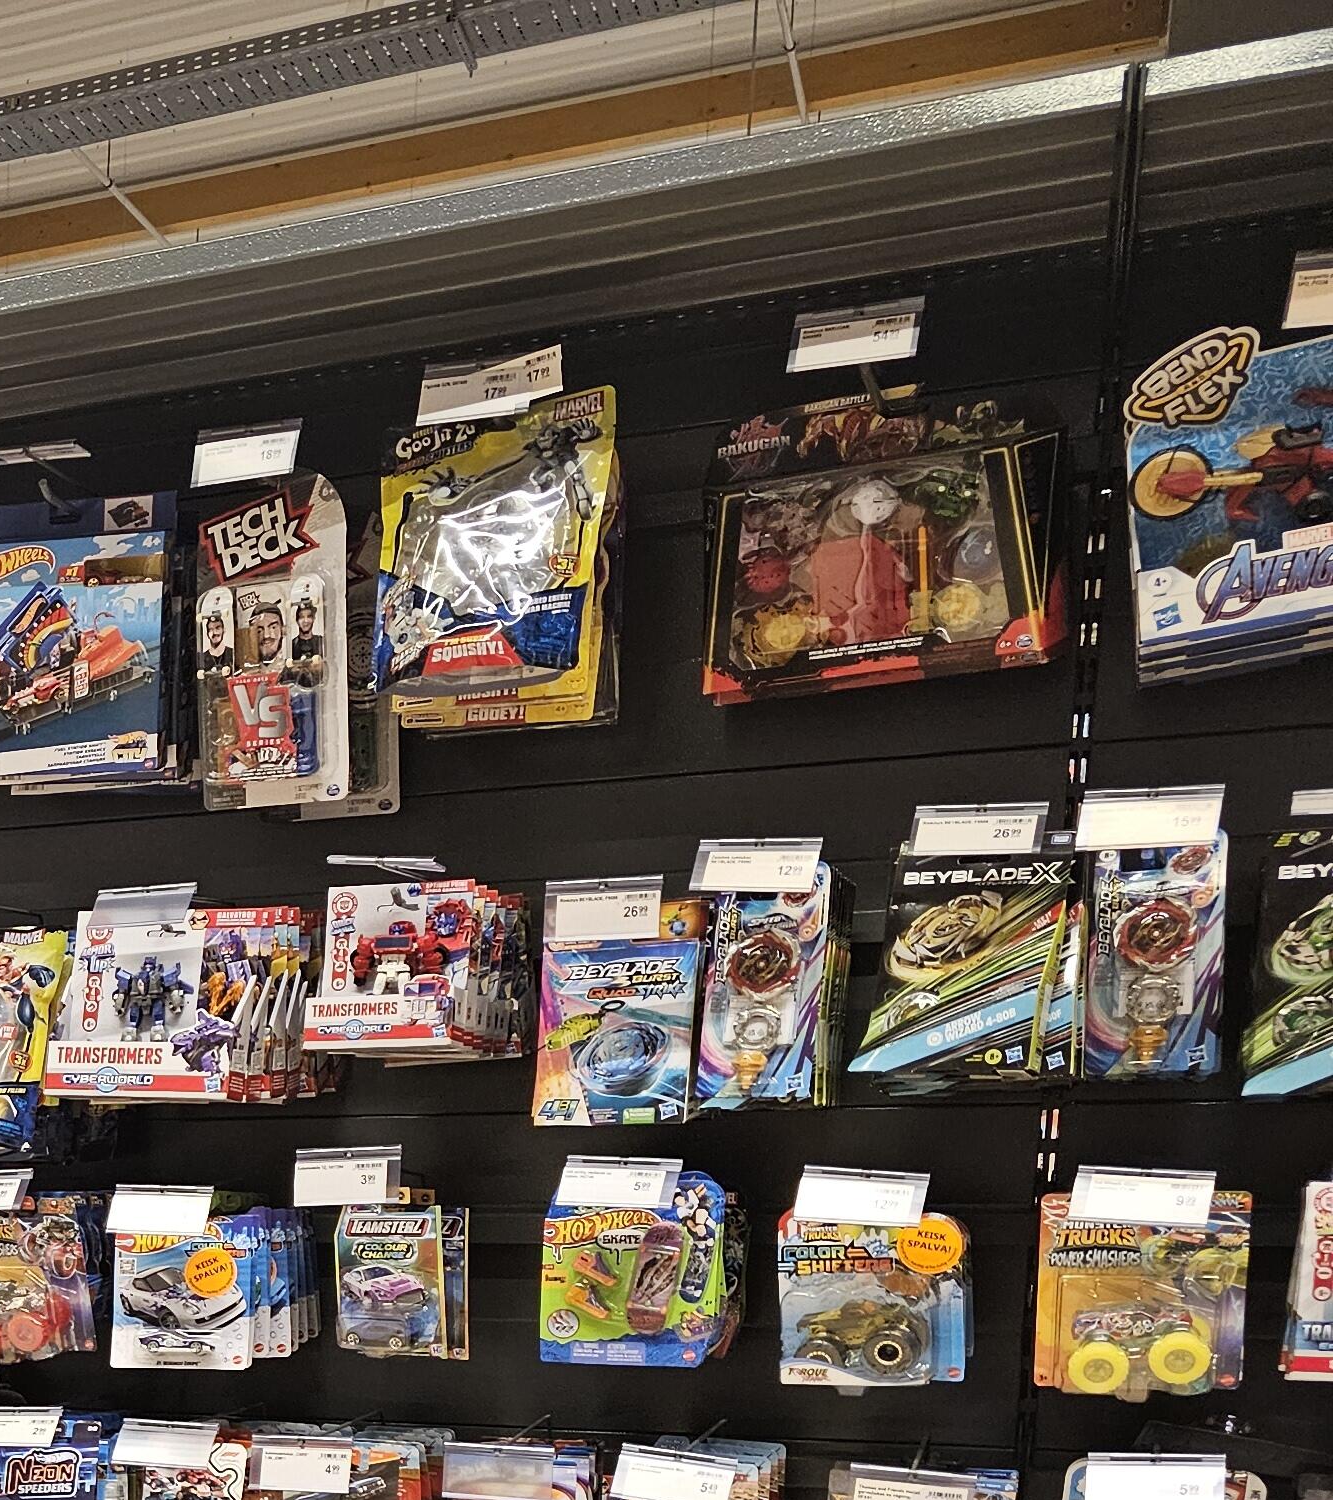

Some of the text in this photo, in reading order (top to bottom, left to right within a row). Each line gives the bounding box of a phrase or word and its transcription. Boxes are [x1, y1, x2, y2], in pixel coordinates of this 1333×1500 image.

[1140, 339, 1227, 399] BEND
[1163, 366, 1245, 425] FLEX
[554, 392, 604, 420] MARVEL
[718, 435, 790, 460] BAKUGAN
[208, 501, 284, 550] TECH
[3, 545, 53, 576] WHEELS
[220, 525, 307, 578] DECK
[431, 641, 504, 662] SQUISHY!
[1097, 880, 1114, 957] BEYBLADE
[3, 929, 45, 945] MARVEL
[570, 959, 680, 981] BEYBLADE
[631, 971, 681, 984] BURST
[312, 1001, 398, 1018] TRANSFORMERS
[317, 1023, 392, 1035] CYBERWORLD
[57, 1046, 163, 1066] TRANSFORMERS
[62, 1072, 154, 1087] CYBERWORLD
[348, 1217, 427, 1236] TEAMSTERZ
[555, 1212, 659, 1245] HOT WHEELS
[917, 1228, 947, 1243] KEISK
[364, 1242, 407, 1252] COLOUR
[602, 1233, 640, 1246] SKATE
[907, 1238, 953, 1255] SPALVA!
[1056, 1228, 1136, 1247] TRUCKS
[195, 1255, 219, 1272] KEISK
[361, 1249, 406, 1260] CHANGE
[783, 1245, 847, 1263] COLOR
[1046, 1250, 1141, 1268] POWER SMASHERS
[193, 1263, 229, 1283] SPALVA!
[9, 1460, 76, 1485] NEON
[18, 1482, 75, 1496] SPEEDERS
